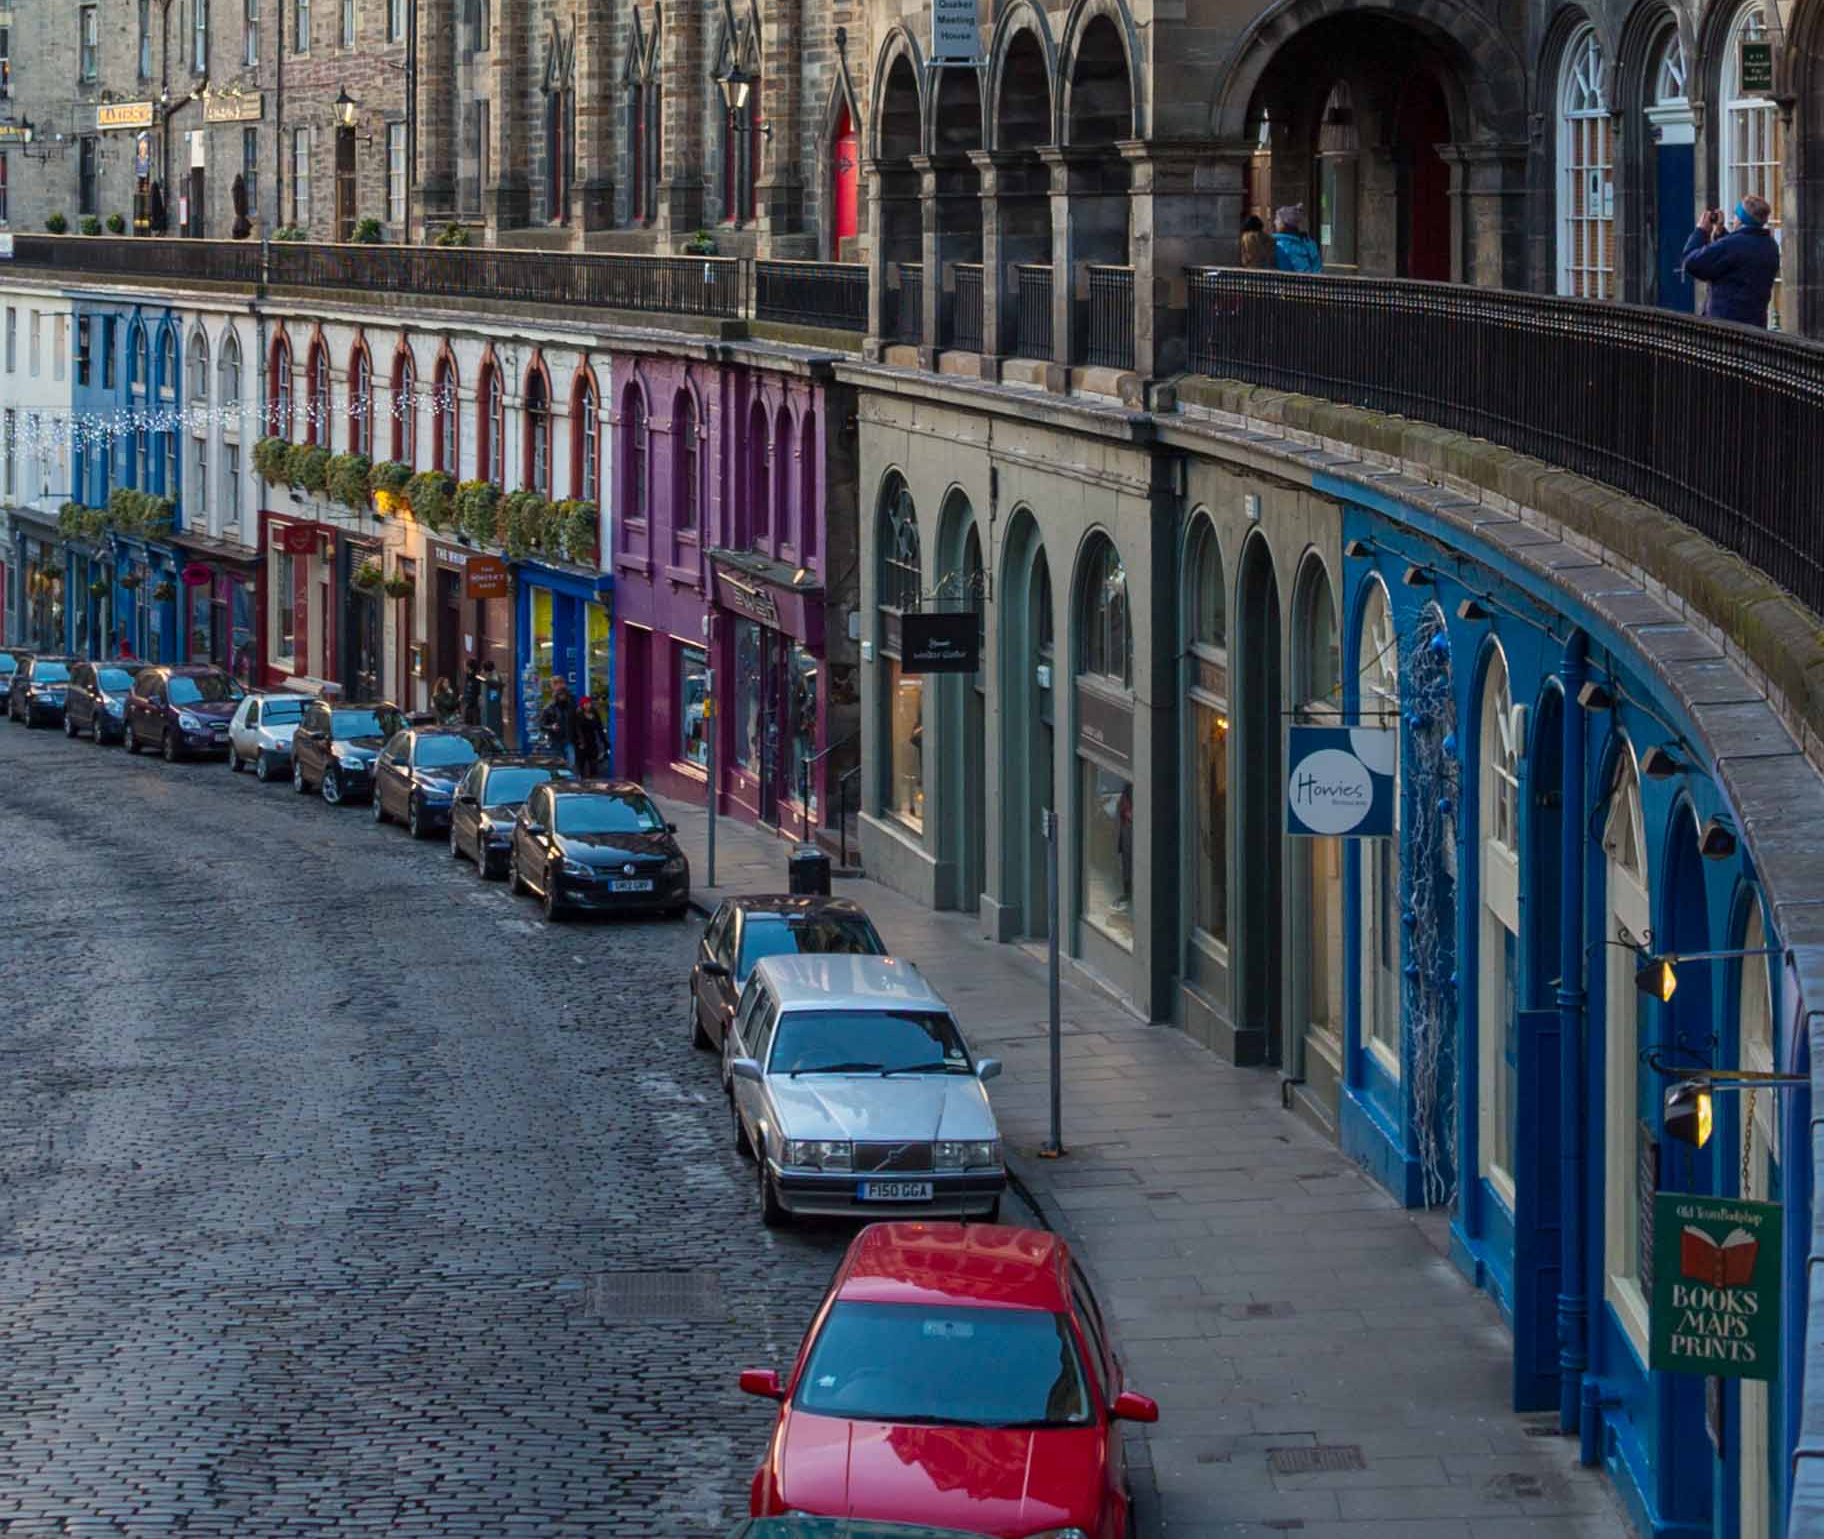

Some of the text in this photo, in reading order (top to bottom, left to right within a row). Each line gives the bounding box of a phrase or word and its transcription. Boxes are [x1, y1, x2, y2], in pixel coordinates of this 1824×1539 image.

[938, 0, 973, 9] Quaker
[936, 15, 975, 27] Meeting
[940, 31, 972, 41] House
[1297, 772, 1363, 806] Howies
[1676, 1204, 1694, 1219] Old
[1671, 1283, 1759, 1316] BOOKS
[1676, 1310, 1750, 1339] MAPS
[1669, 1334, 1758, 1363] PRINTS
